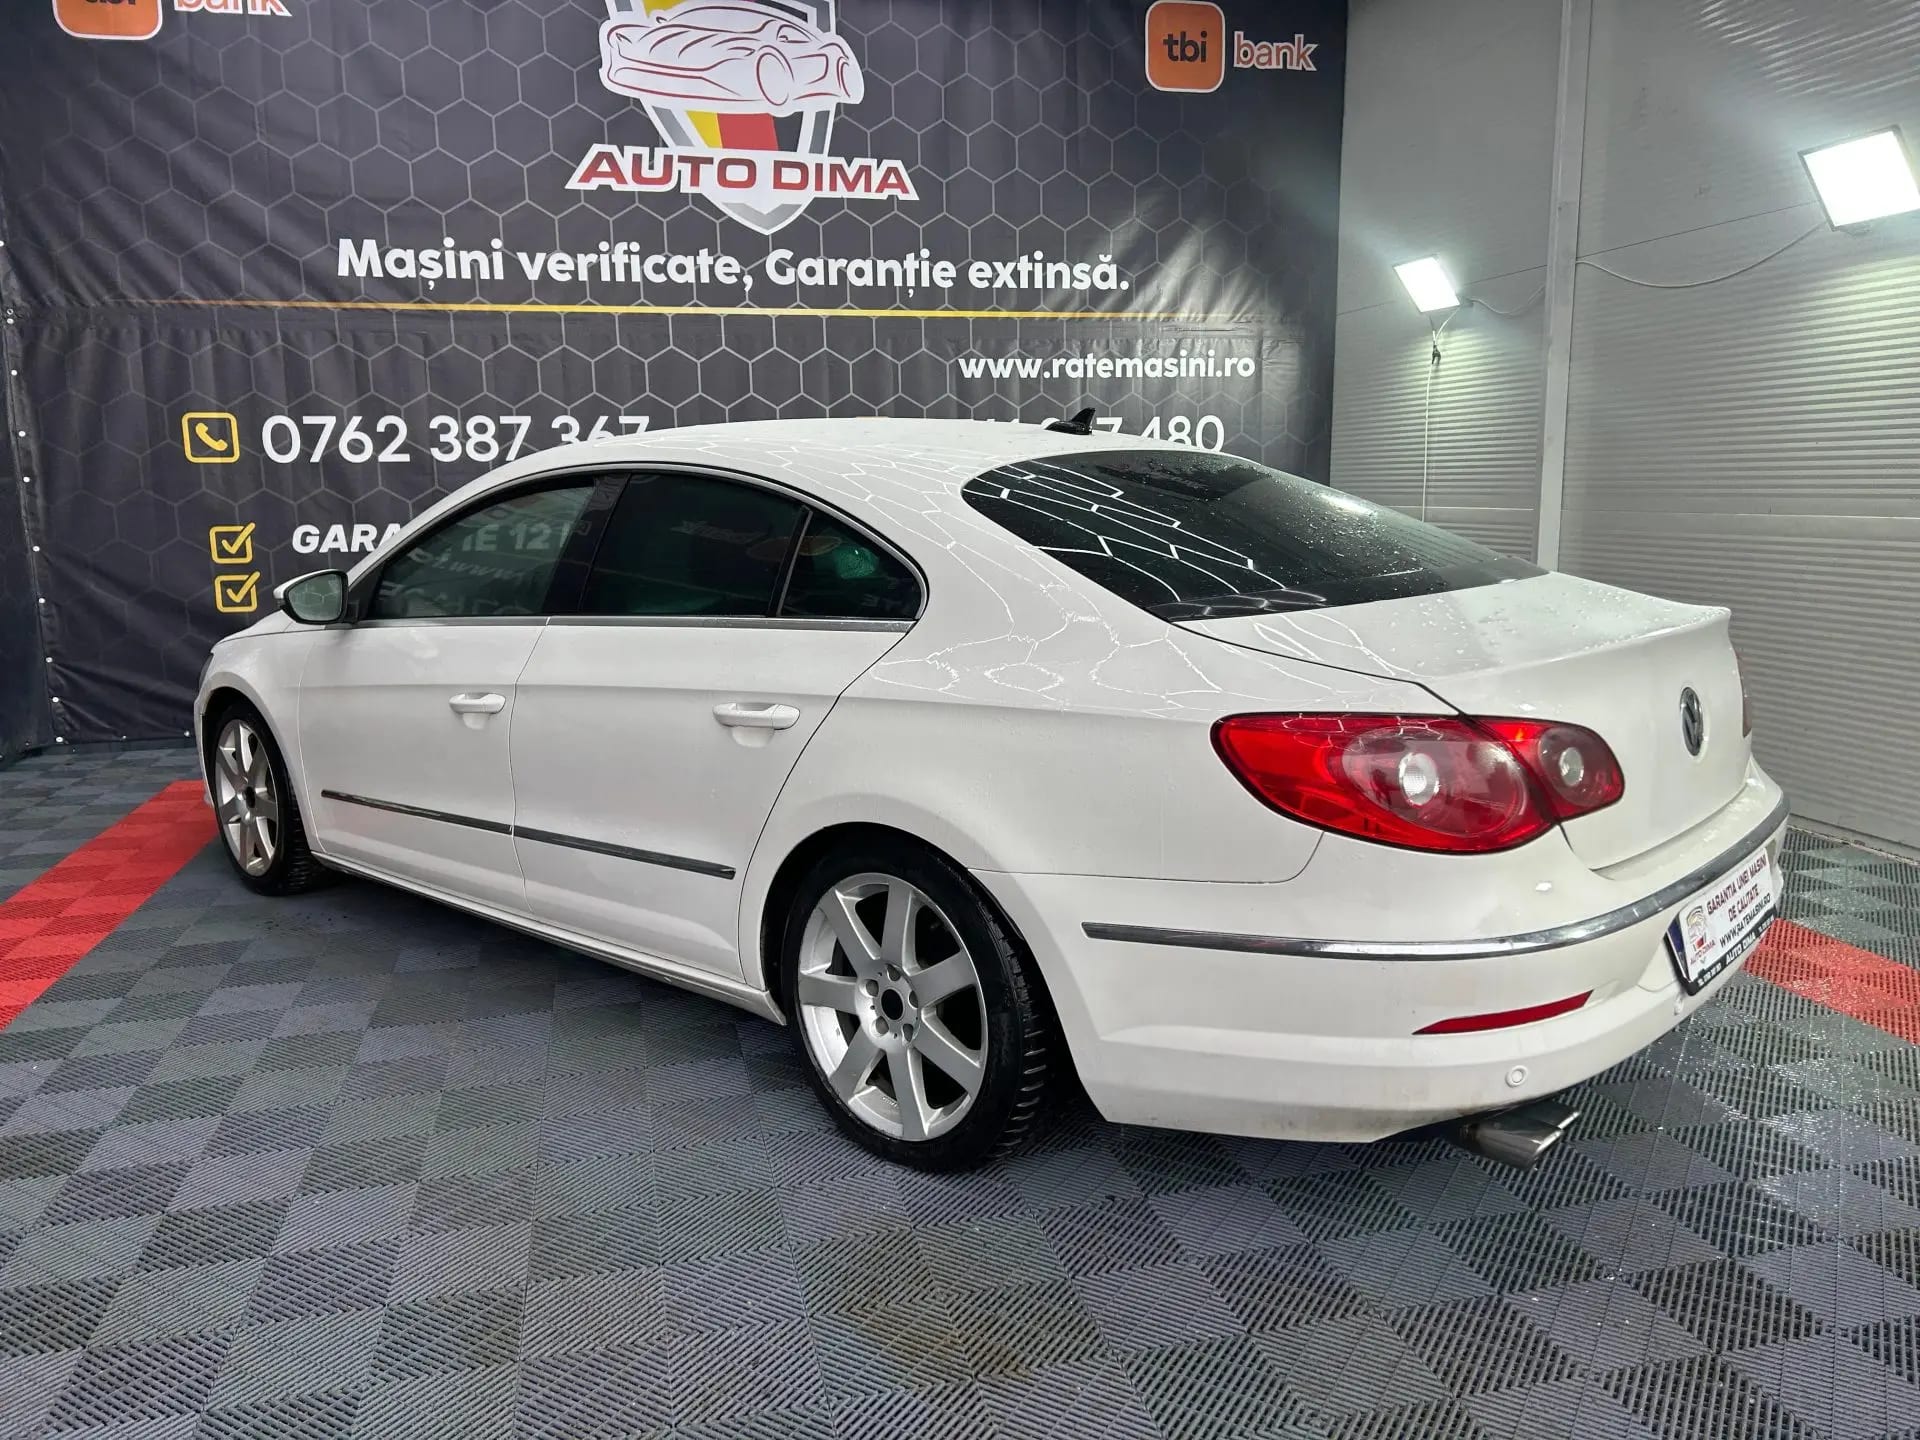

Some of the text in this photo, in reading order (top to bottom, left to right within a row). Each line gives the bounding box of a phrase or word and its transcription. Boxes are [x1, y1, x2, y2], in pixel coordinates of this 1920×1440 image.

[1163, 31, 1318, 71] tbi bank
[577, 152, 910, 195] AUTO DIMA
[337, 237, 1129, 298] Mașini verificate, Garanție extinsă.
[958, 349, 1256, 379] www.ratemasini.ro
[261, 415, 411, 463] 0762
[429, 415, 532, 462] 387
[1706, 853, 1767, 916] GARANTIA UNEI MASINI
[1728, 883, 1760, 922] DE CALITATE
[1725, 942, 1743, 965] AUTO
